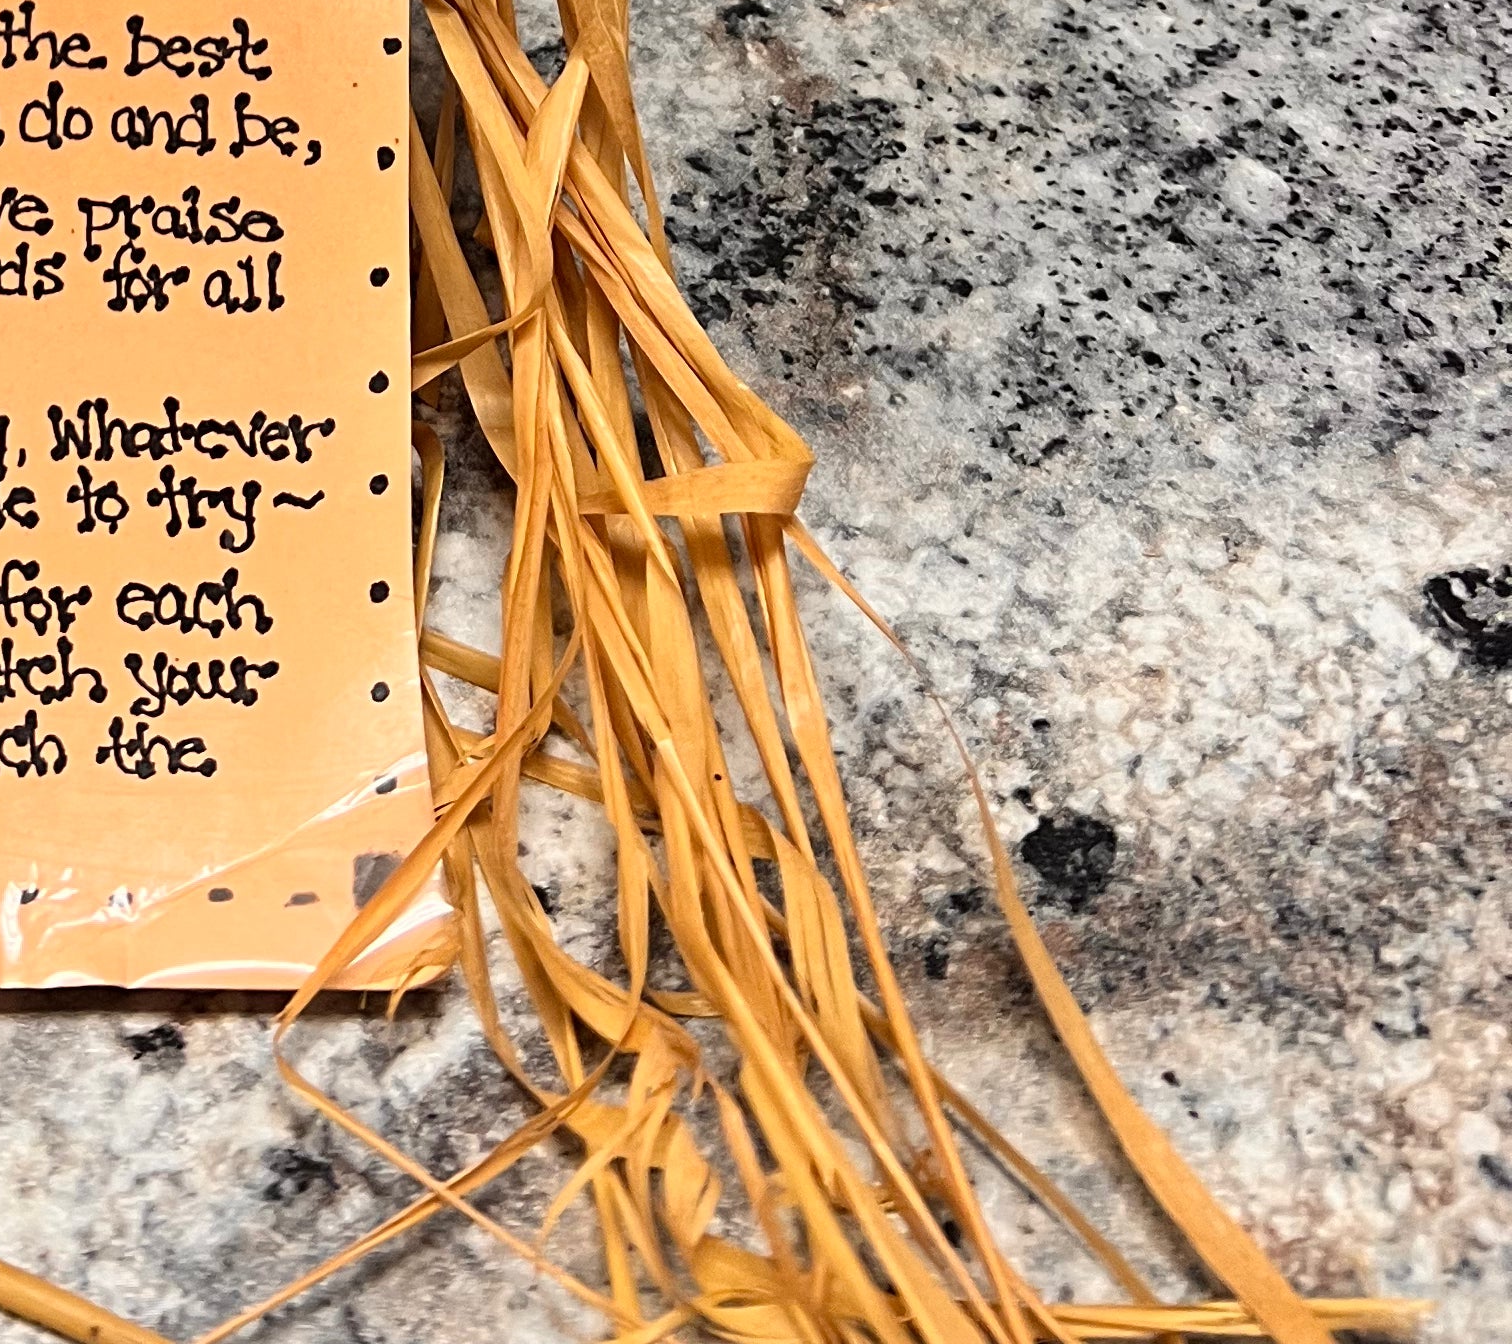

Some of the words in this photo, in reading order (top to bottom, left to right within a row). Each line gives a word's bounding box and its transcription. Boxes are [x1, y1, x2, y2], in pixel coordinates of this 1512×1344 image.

[125, 15, 273, 80] best
[18, 80, 93, 149] do
[111, 94, 216, 156] and
[230, 92, 323, 167] be,
[78, 186, 284, 259] praise
[102, 242, 190, 311] for
[203, 251, 286, 312] all
[68, 467, 129, 534] to
[116, 569, 274, 636] each
[123, 652, 278, 715] your
[96, 716, 217, 779] the
